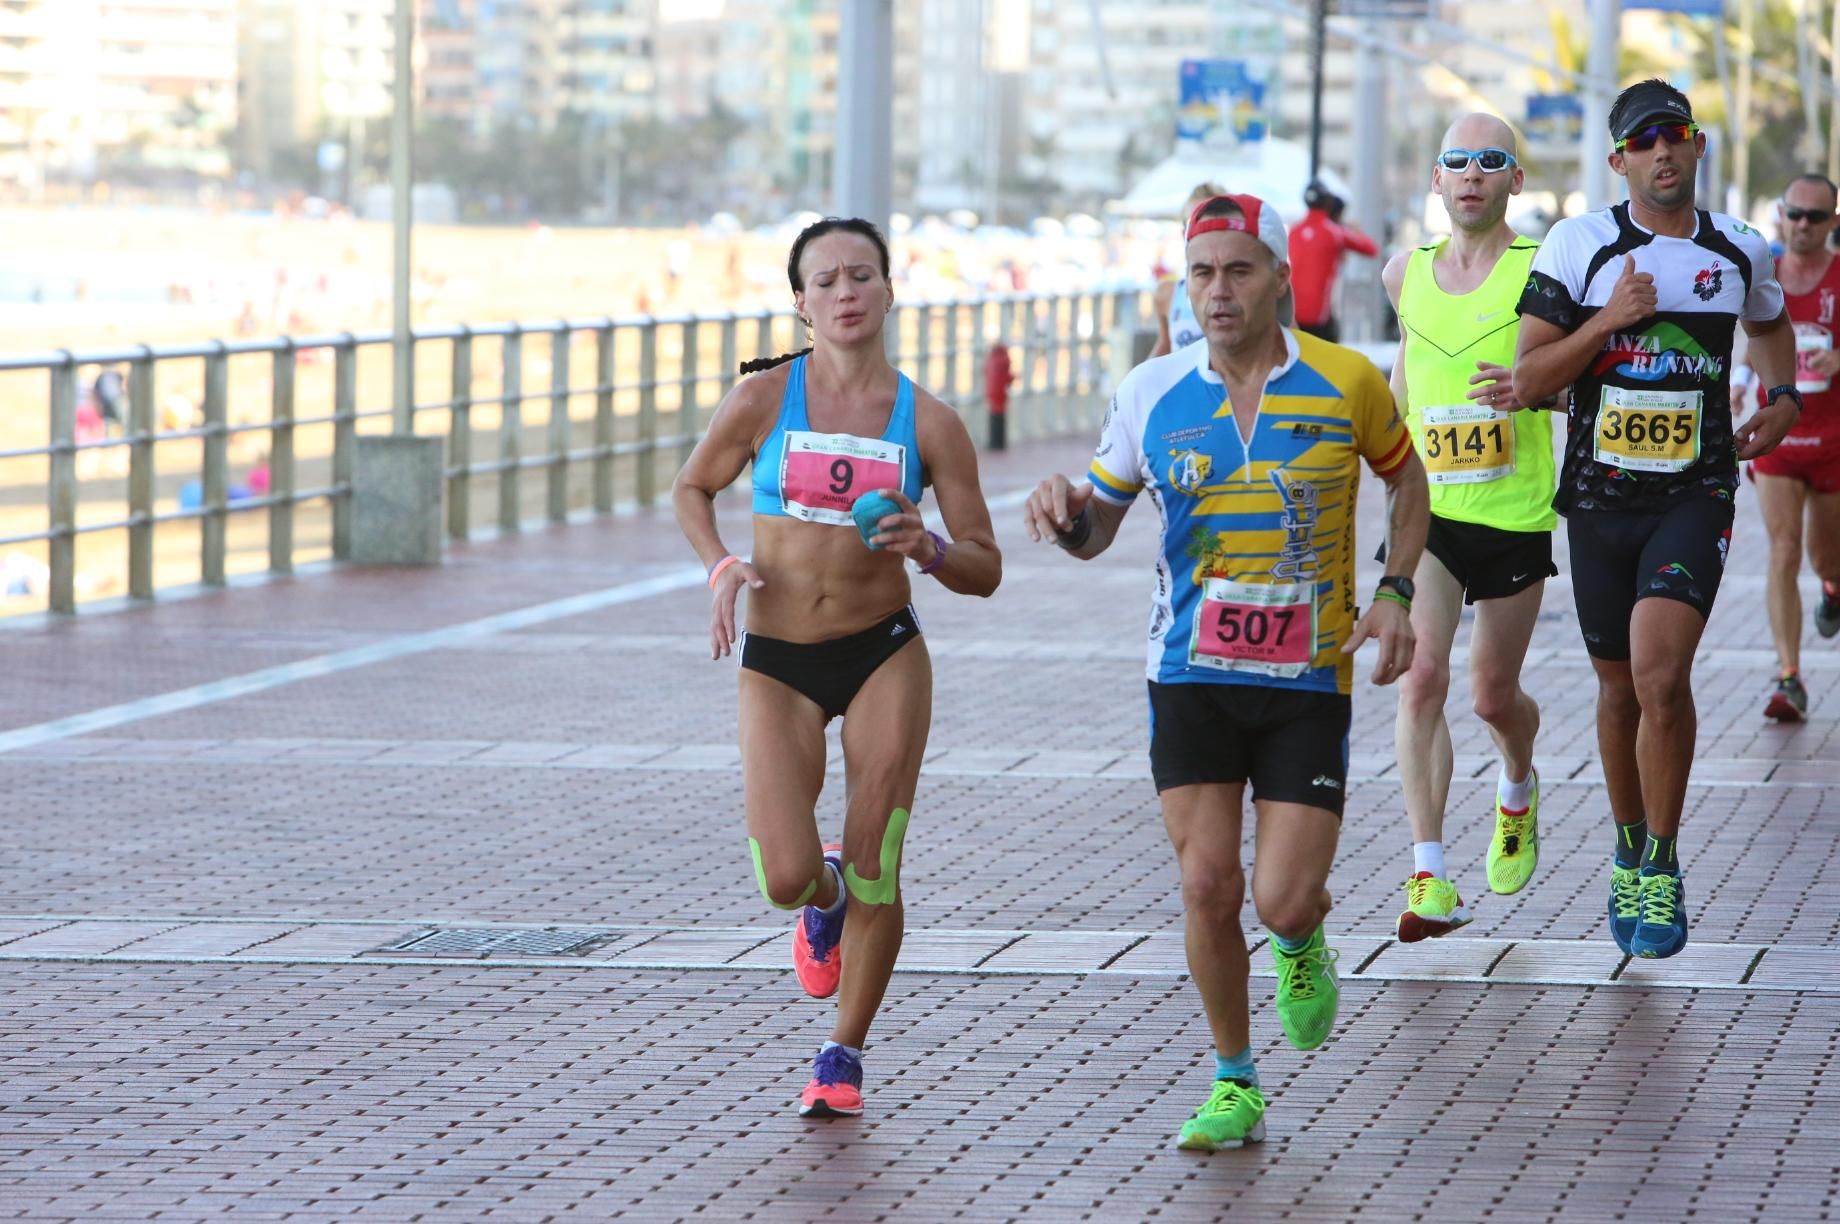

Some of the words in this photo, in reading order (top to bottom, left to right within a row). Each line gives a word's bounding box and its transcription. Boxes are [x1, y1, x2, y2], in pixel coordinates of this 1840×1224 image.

[1603, 334, 1660, 353] ANZA
[1631, 353, 1723, 380] RUNNING
[1602, 410, 1693, 445] 3665
[1427, 424, 1502, 458] 3141
[1628, 444, 1649, 452] SAUL
[1450, 457, 1480, 465] JARKKO
[828, 458, 853, 495] 9
[821, 494, 856, 504] JUNNIL
[1216, 607, 1294, 646] 507
[1232, 645, 1265, 654] VICTOR
